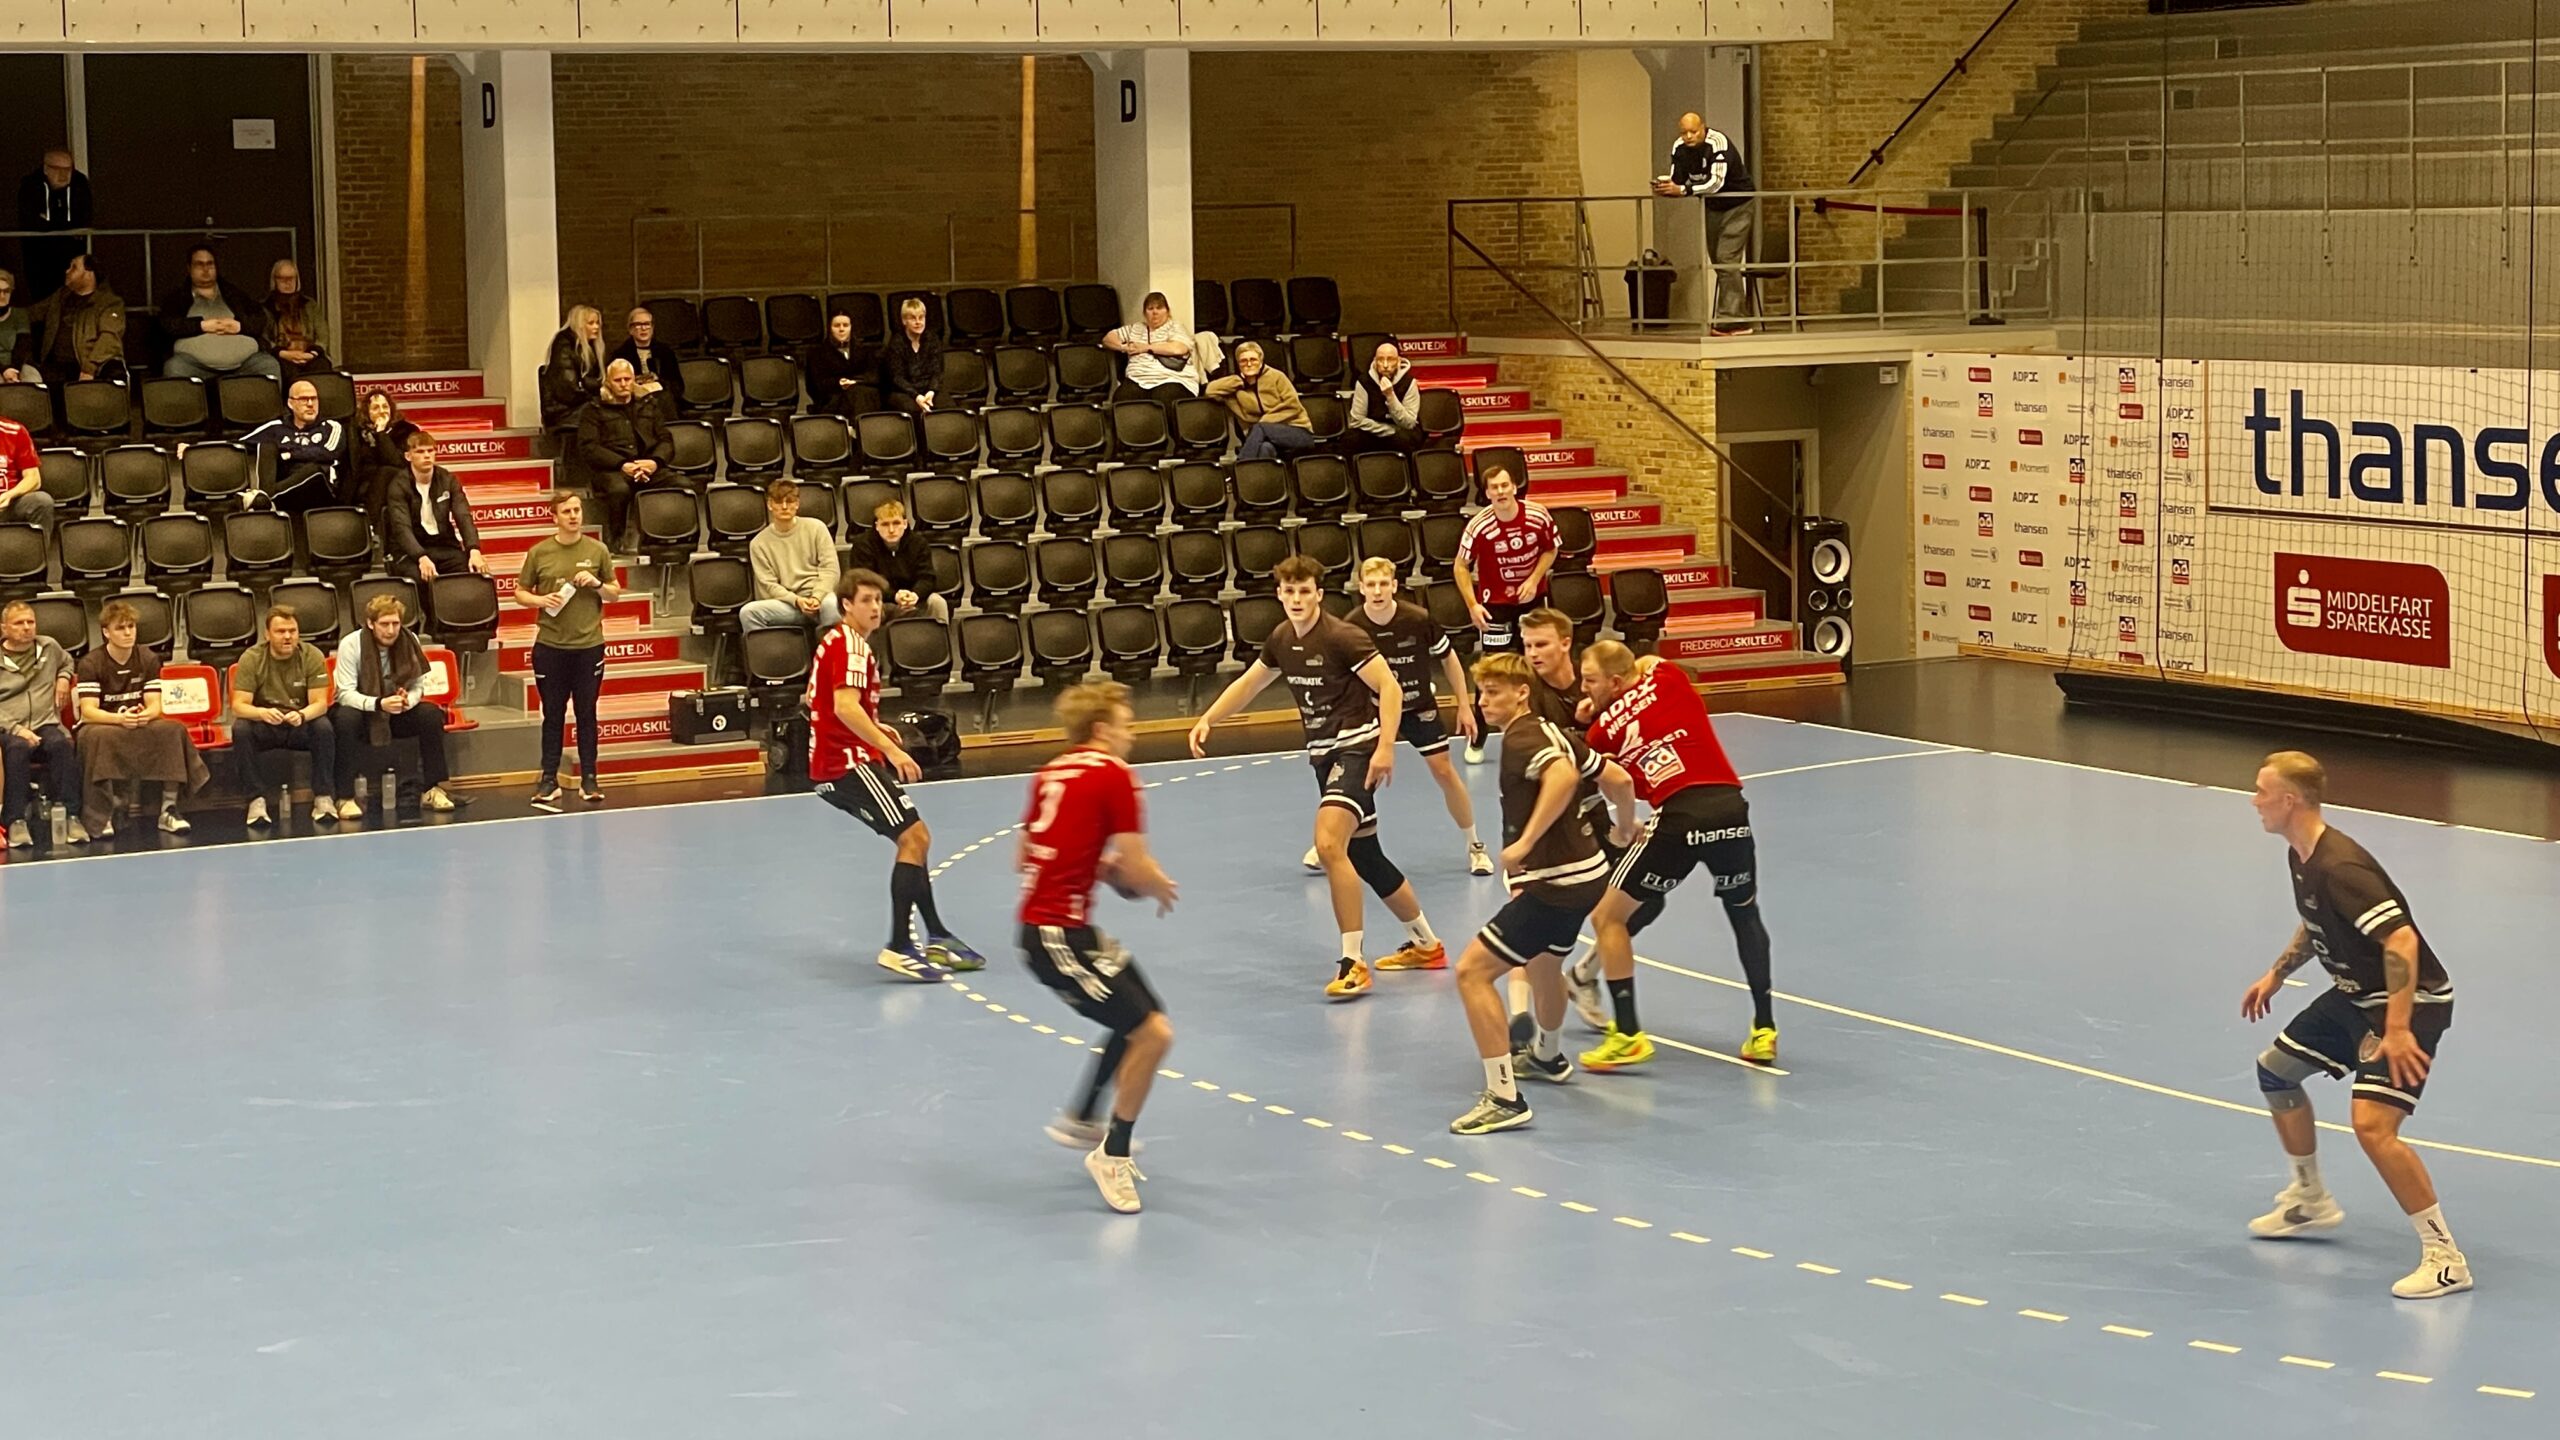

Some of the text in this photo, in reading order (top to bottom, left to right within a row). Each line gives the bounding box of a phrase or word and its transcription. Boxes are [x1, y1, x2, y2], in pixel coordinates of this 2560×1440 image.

[482, 83, 495, 128] D
[1121, 80, 1136, 122] D
[2014, 401, 2048, 413] thansen
[1923, 427, 1954, 438] thansen
[437, 441, 505, 454] IASKILTE.DK
[2107, 468, 2142, 480] thansen
[471, 505, 554, 520] ICIASKILTE.DK
[2014, 522, 2048, 535] thansen
[1923, 544, 1955, 556] thansen
[1663, 571, 1710, 584] SKILTE.DK
[2108, 591, 2143, 604] thansen
[2327, 590, 2433, 618] MIDDELFART
[2327, 611, 2432, 639] SPAREKASSE
[1680, 635, 1783, 652] FREDERICIASKILTE.DK
[1600, 676, 1658, 727] ADPX
[1607, 692, 1657, 740] NIELSEN
[1618, 720, 1644, 757] 4
[1619, 729, 1688, 768] hansen
[843, 746, 870, 769] 15
